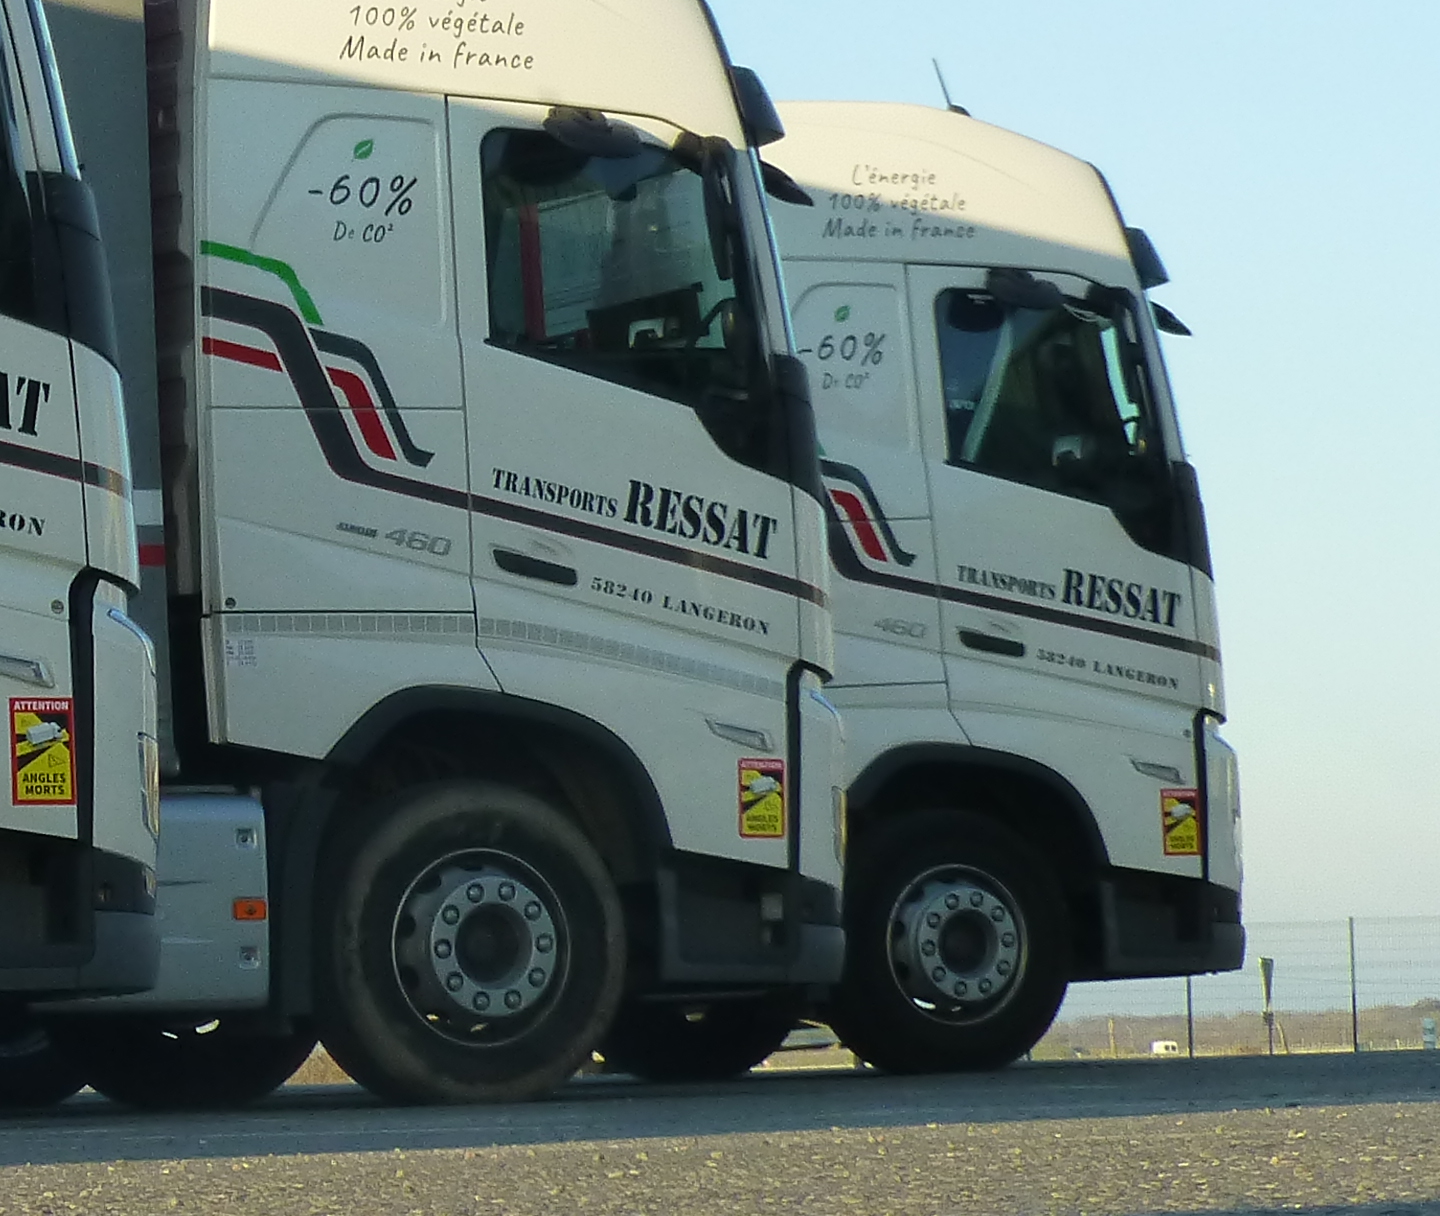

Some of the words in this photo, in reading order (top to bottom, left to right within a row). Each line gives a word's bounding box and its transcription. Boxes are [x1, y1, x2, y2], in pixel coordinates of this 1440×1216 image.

[349, 4, 416, 32] 100%
[428, 11, 525, 38] végétale
[338, 34, 409, 63] Made
[419, 42, 443, 63] in
[452, 41, 535, 70] france
[851, 163, 937, 191] L'énergie
[308, 173, 418, 217] -60%
[828, 191, 881, 212] 100%
[889, 195, 967, 215] végétale
[821, 216, 878, 239] Made
[884, 219, 905, 236] in
[491, 467, 619, 519] TRANSPORTS
[622, 478, 779, 560] RESSAT
[383, 526, 453, 558] 460
[590, 576, 655, 606] 58240
[662, 594, 771, 637] LANGERON
[956, 563, 1056, 600] TRANSPORTS
[1061, 568, 1182, 627] RESSAT
[1092, 658, 1180, 691] LANGERON
[11, 698, 70, 712] ATTENTION
[21, 771, 67, 784] ANGLES
[23, 784, 66, 798] MORTS
